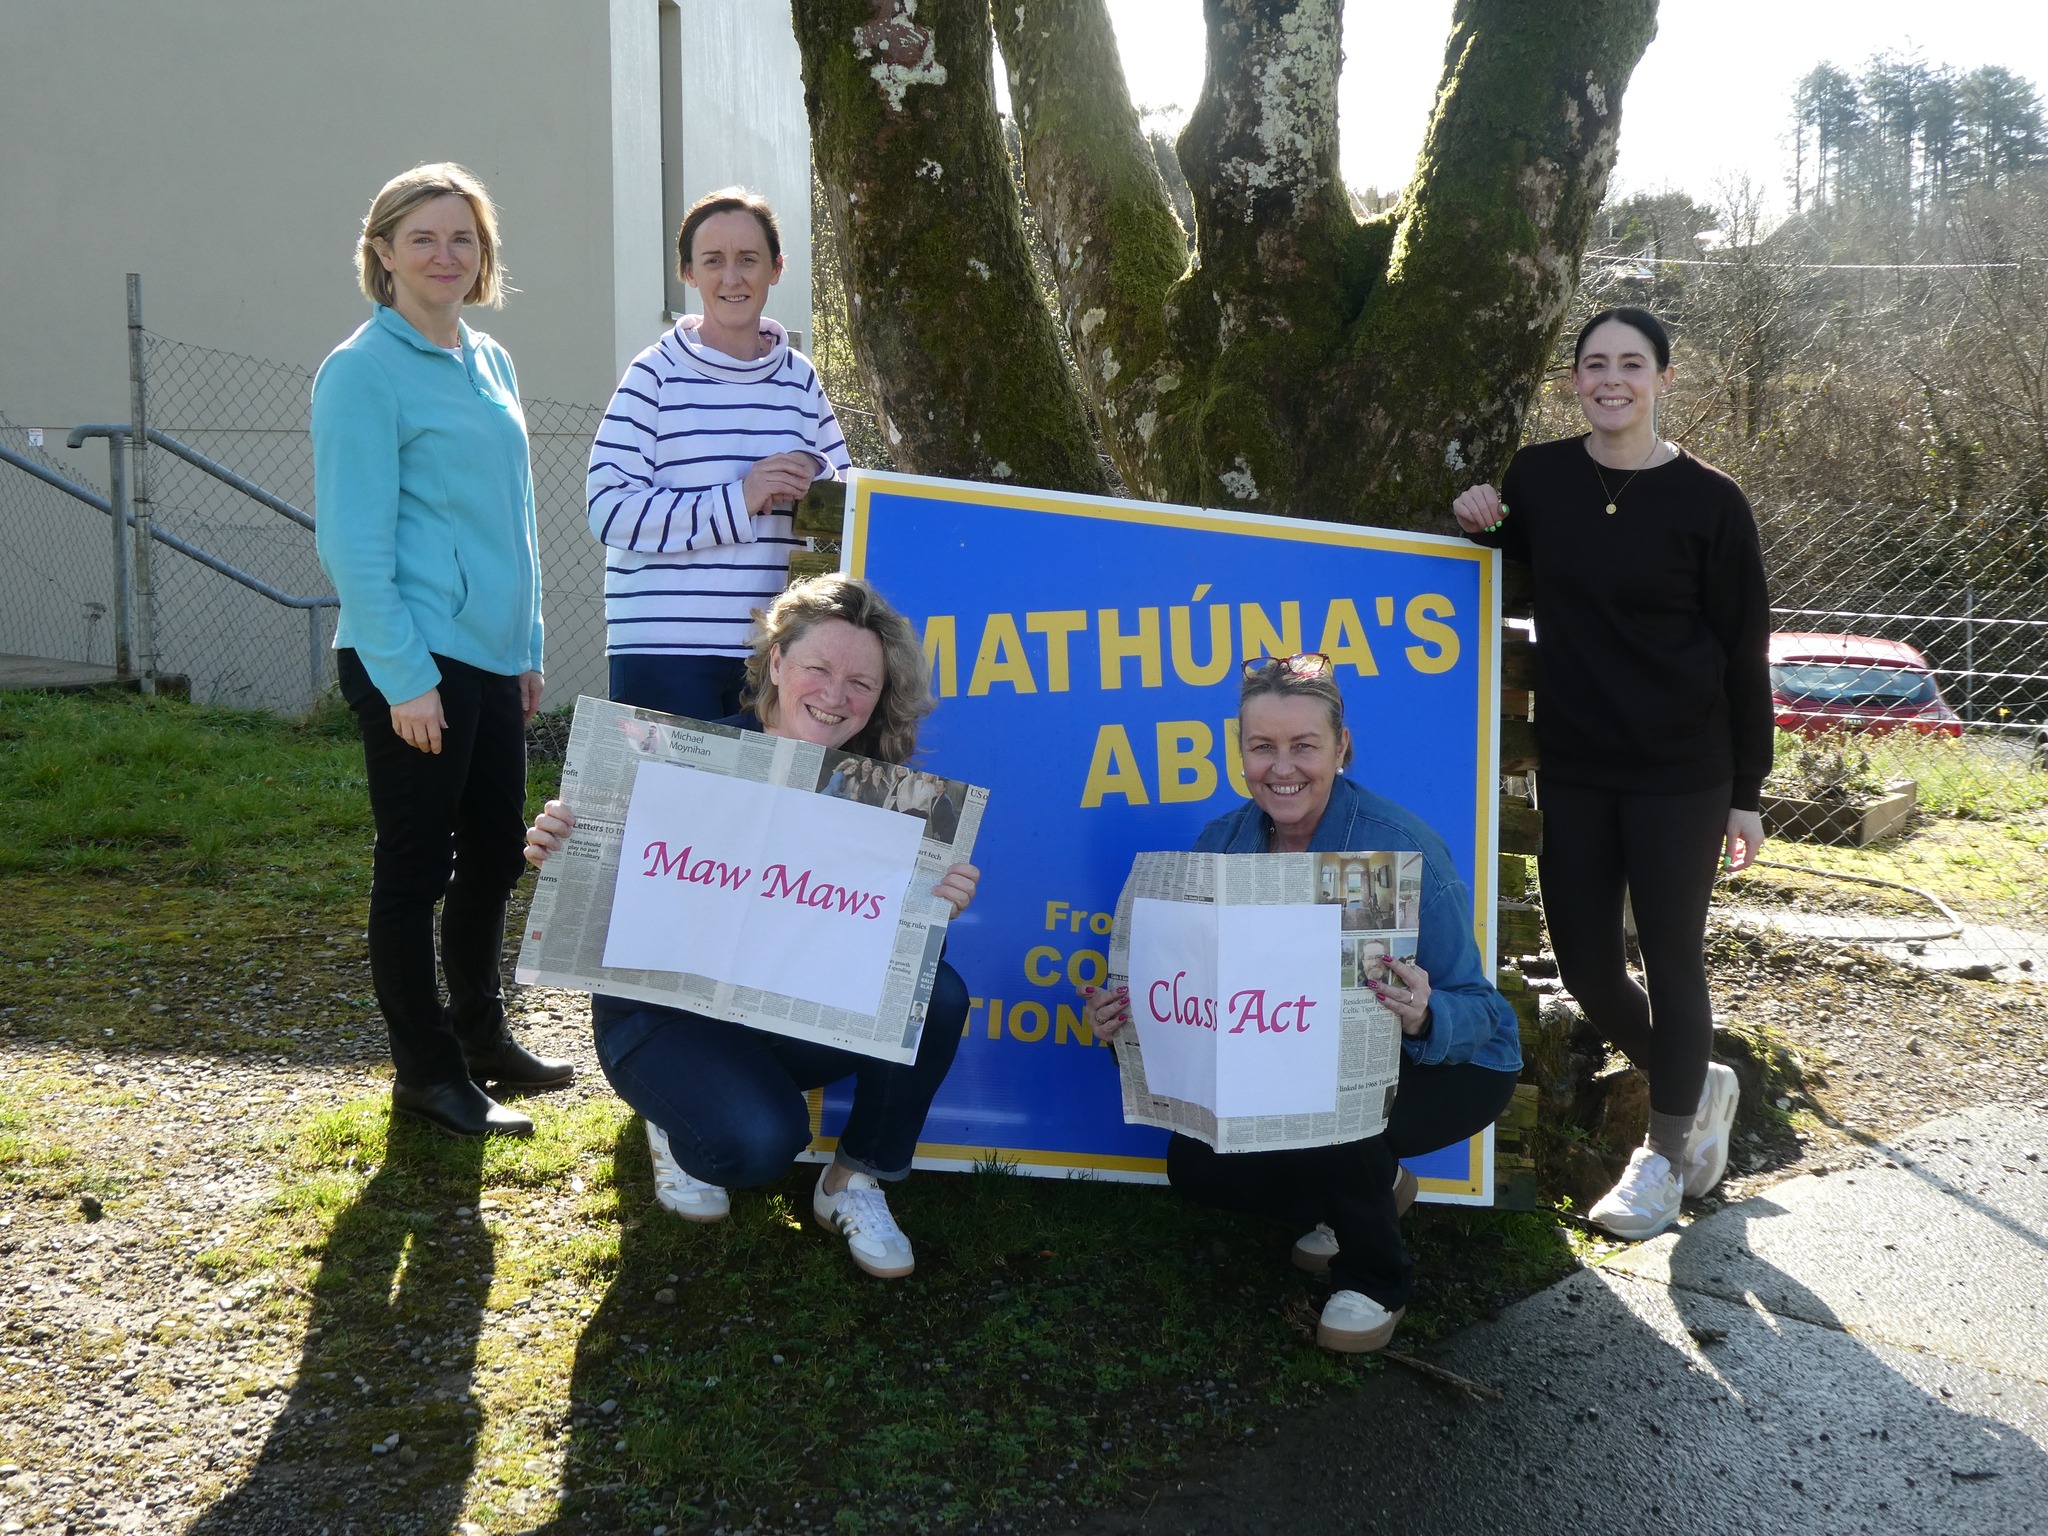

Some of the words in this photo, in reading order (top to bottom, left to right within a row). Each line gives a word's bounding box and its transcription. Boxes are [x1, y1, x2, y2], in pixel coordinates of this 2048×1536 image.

[671, 730, 704, 744] Michael
[669, 741, 711, 757] Moynihan
[970, 788, 983, 799] US
[573, 821, 604, 833] Letters
[605, 826, 615, 834] to
[567, 844, 580, 852] play
[569, 838, 583, 846] State
[583, 839, 602, 848] should
[581, 852, 601, 861] military
[928, 850, 942, 861] tech
[539, 875, 558, 883] urns
[642, 841, 752, 891] Maw
[759, 864, 886, 920] Maws
[911, 922, 927, 930] rules
[1149, 971, 1218, 1031] Class
[1228, 989, 1317, 1034] Act
[1343, 997, 1374, 1006] Residential
[1342, 1005, 1360, 1014] Celtic
[1361, 1004, 1376, 1015] Tiger
[1339, 1083, 1357, 1093] linked
